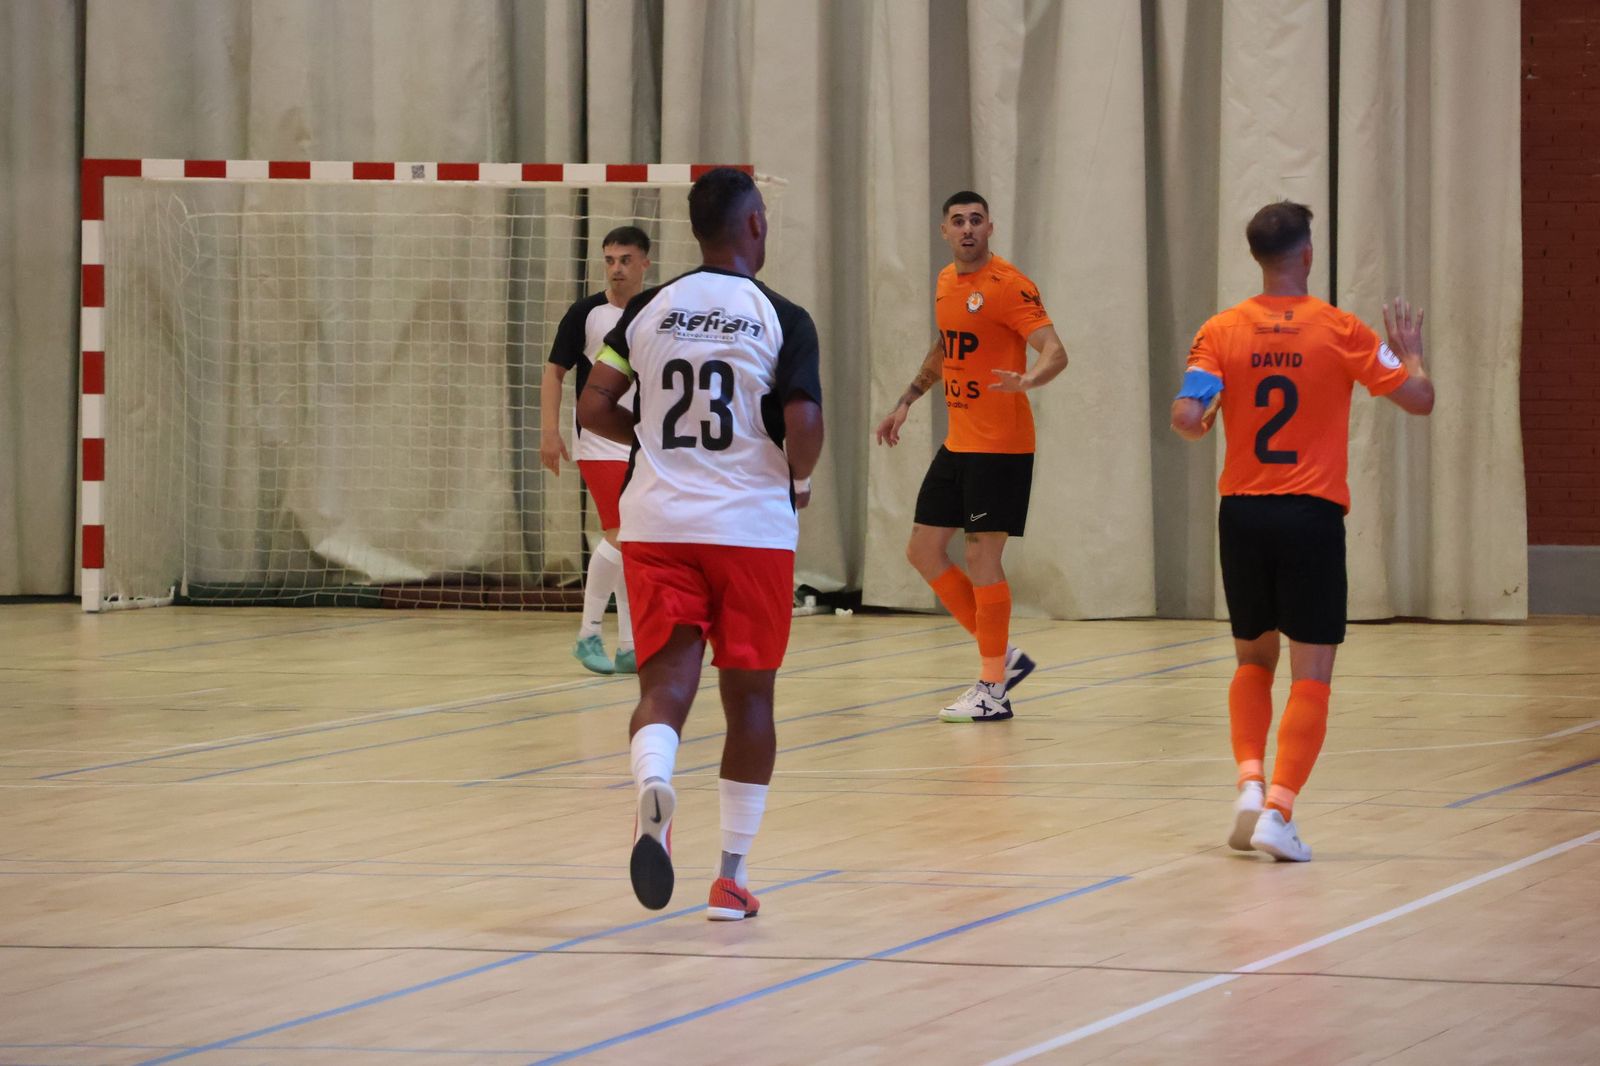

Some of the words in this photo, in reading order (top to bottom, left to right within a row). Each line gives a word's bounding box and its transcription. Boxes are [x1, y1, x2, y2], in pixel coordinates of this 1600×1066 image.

[662, 358, 734, 451] 23
[1251, 352, 1303, 368] DAVID
[1254, 374, 1299, 464] 2
